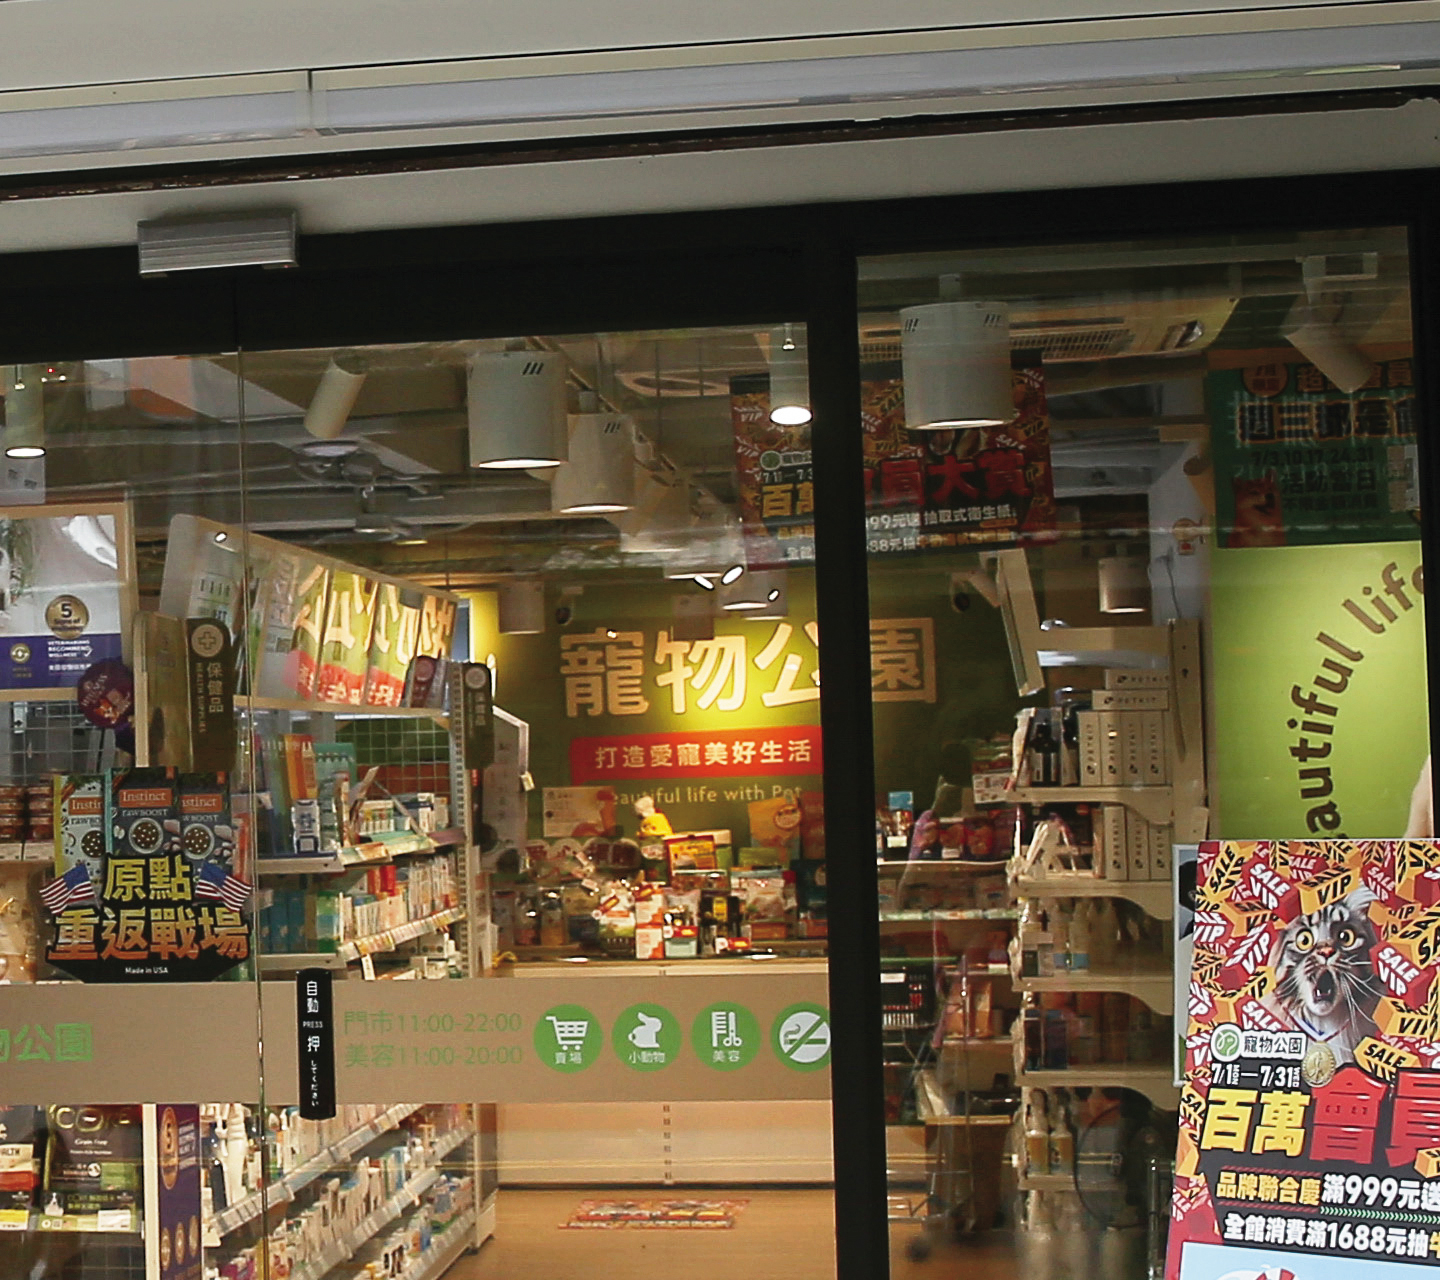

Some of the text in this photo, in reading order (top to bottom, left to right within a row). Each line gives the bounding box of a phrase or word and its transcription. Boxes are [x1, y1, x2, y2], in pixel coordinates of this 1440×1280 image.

[59, 602, 73, 619] 5
[206, 660, 225, 714] 保健品
[595, 737, 812, 769] 打造愛寵美好生活
[122, 790, 167, 802] Instinct
[103, 854, 193, 902] 原點
[1250, 863, 1291, 897] SALE
[1250, 876, 1279, 910] VIP
[1317, 872, 1352, 905] VIP
[47, 905, 249, 961] 重返戰場
[1193, 925, 1226, 943] VIP
[125, 966, 143, 974] Made
[153, 966, 169, 974] USA
[1241, 934, 1270, 975] VIP
[305, 980, 319, 1015] 自動
[306, 1035, 320, 1053] 押
[554, 1051, 583, 1065] 賣場
[628, 1049, 666, 1065] 小動物
[712, 1049, 741, 1064] 美容
[1243, 1036, 1302, 1054] 寵物公園
[309, 1059, 320, 1108] してください
